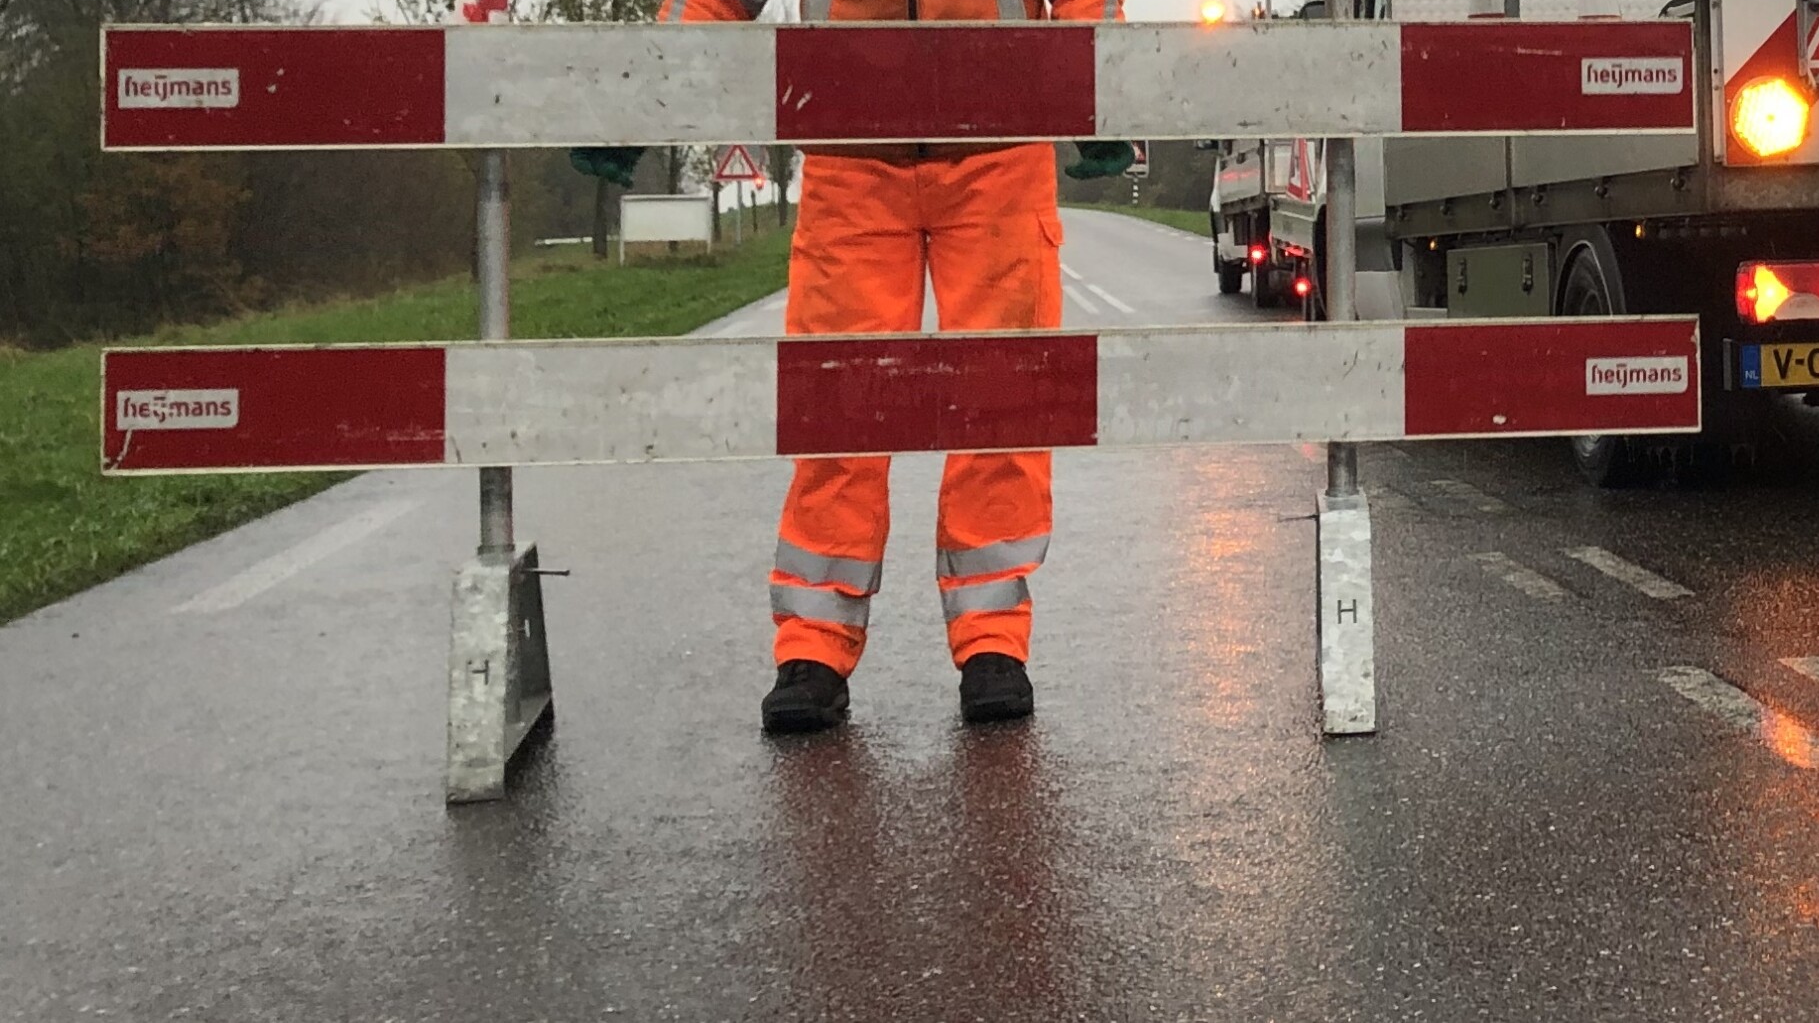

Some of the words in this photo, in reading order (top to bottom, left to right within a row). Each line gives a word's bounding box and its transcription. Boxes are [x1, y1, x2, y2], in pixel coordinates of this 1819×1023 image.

[125, 75, 232, 101] heijmans
[1587, 63, 1678, 88] heijmans
[1591, 363, 1682, 388] heijmans
[1745, 370, 1759, 380] NL
[1337, 599, 1357, 624] H
